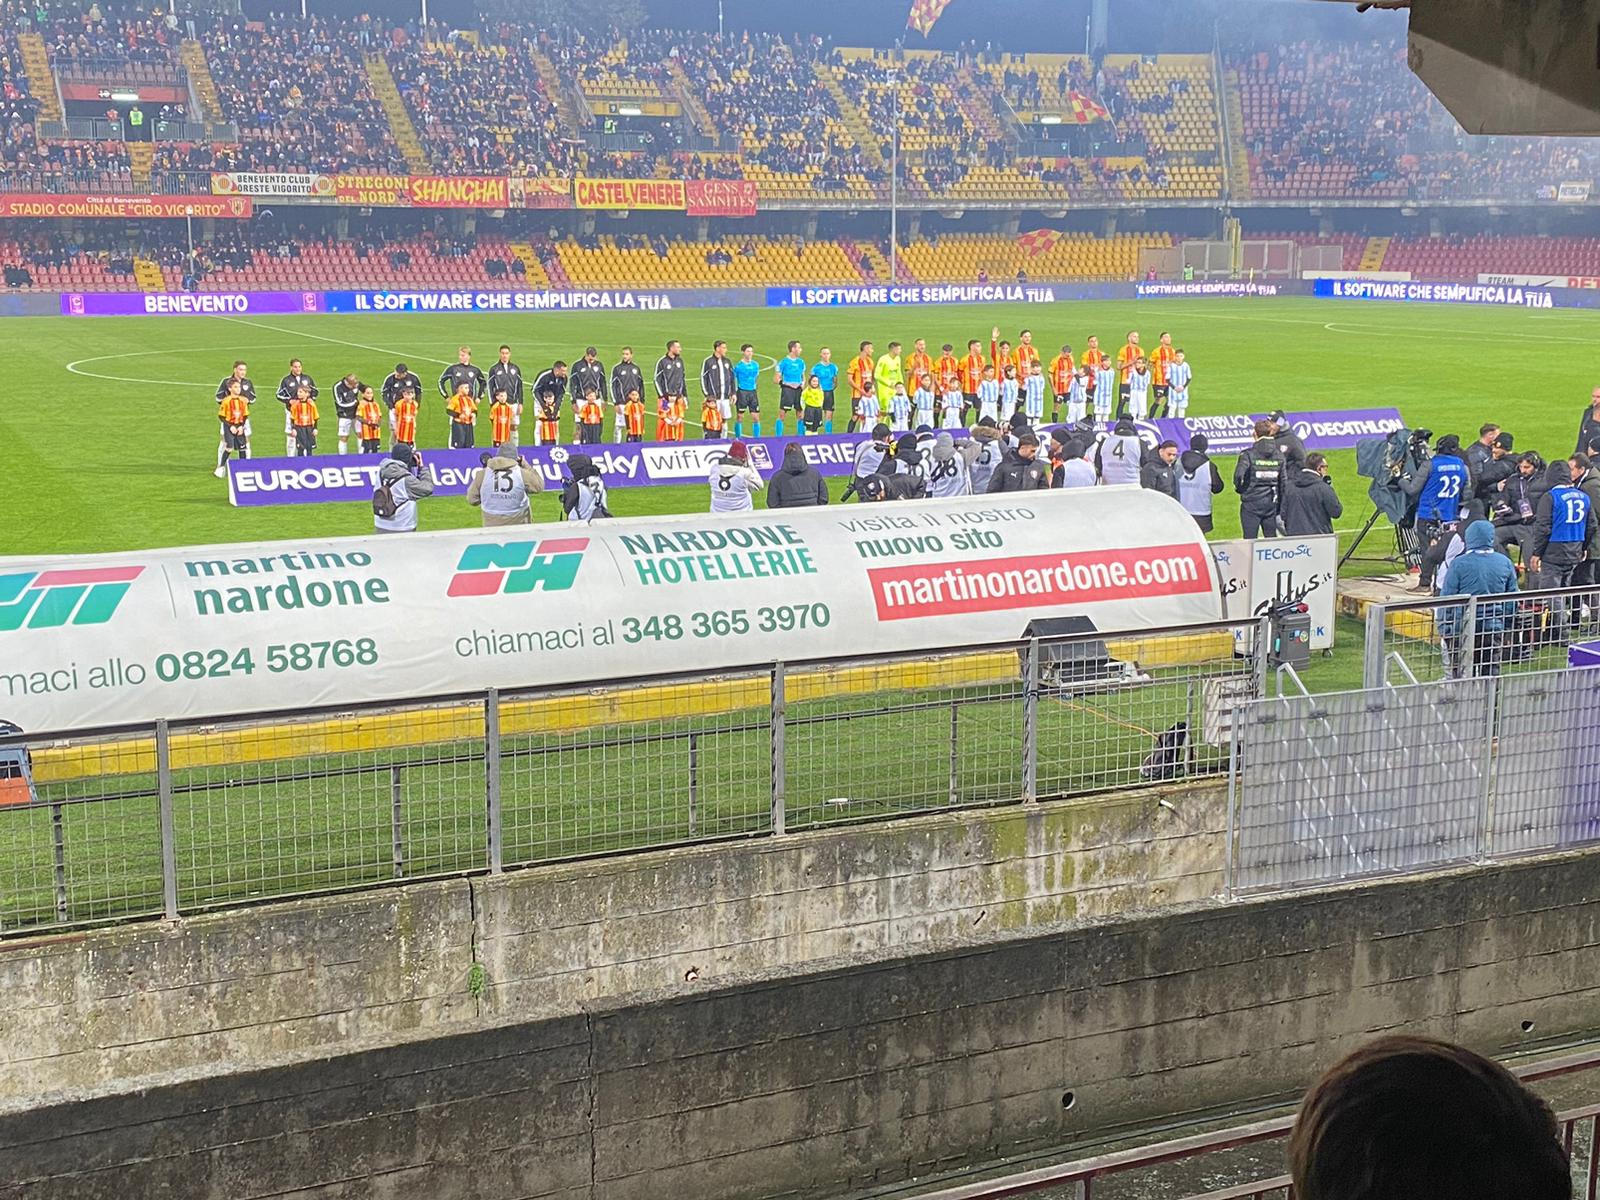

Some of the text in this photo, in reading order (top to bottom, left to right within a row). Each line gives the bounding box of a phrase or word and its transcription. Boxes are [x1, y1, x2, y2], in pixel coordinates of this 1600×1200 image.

[237, 175, 310, 184] BENEVENTO CLUB
[237, 184, 312, 193] ORESTE VIGORITO
[337, 176, 410, 189] STREGONI
[412, 177, 504, 204] SHANGHAI
[704, 182, 738, 194] GENS
[359, 191, 396, 203] NORD
[10, 203, 55, 215] STADIO
[58, 204, 126, 216] COMUNALE
[144, 294, 249, 312] BENEVENTO
[356, 290, 672, 310] IL SOFTWARE CHE SEMPLIFICA LA TUA
[792, 286, 1054, 304] IL SOFTWARE CHE SEMPLIFICA LA TUA
[1333, 282, 1553, 308] IL SOFTWARE CHE SEMPLIFICA LA TUA
[1184, 414, 1256, 431] CATTOLICA
[1312, 418, 1404, 437] DECATHLON
[650, 450, 701, 470] wifi
[801, 442, 855, 464] ERIE
[1112, 439, 1125, 460] 4
[235, 466, 380, 492] EUROBET
[492, 469, 514, 493] 13
[1438, 474, 1460, 498] 23
[838, 505, 1036, 534] visita il nostro
[1565, 500, 1585, 524] 13
[618, 524, 805, 556] NARDONE
[855, 527, 1004, 558] nuovo sito
[184, 549, 373, 578] martino
[634, 547, 818, 586] HOTELLERIE
[882, 554, 1199, 607] martinonardone.com
[192, 575, 391, 616] nardone
[455, 602, 832, 658] chiamaci al 348 365 3970
[88, 658, 146, 690] allo
[154, 648, 256, 684] 0824
[266, 638, 379, 674] 58768
